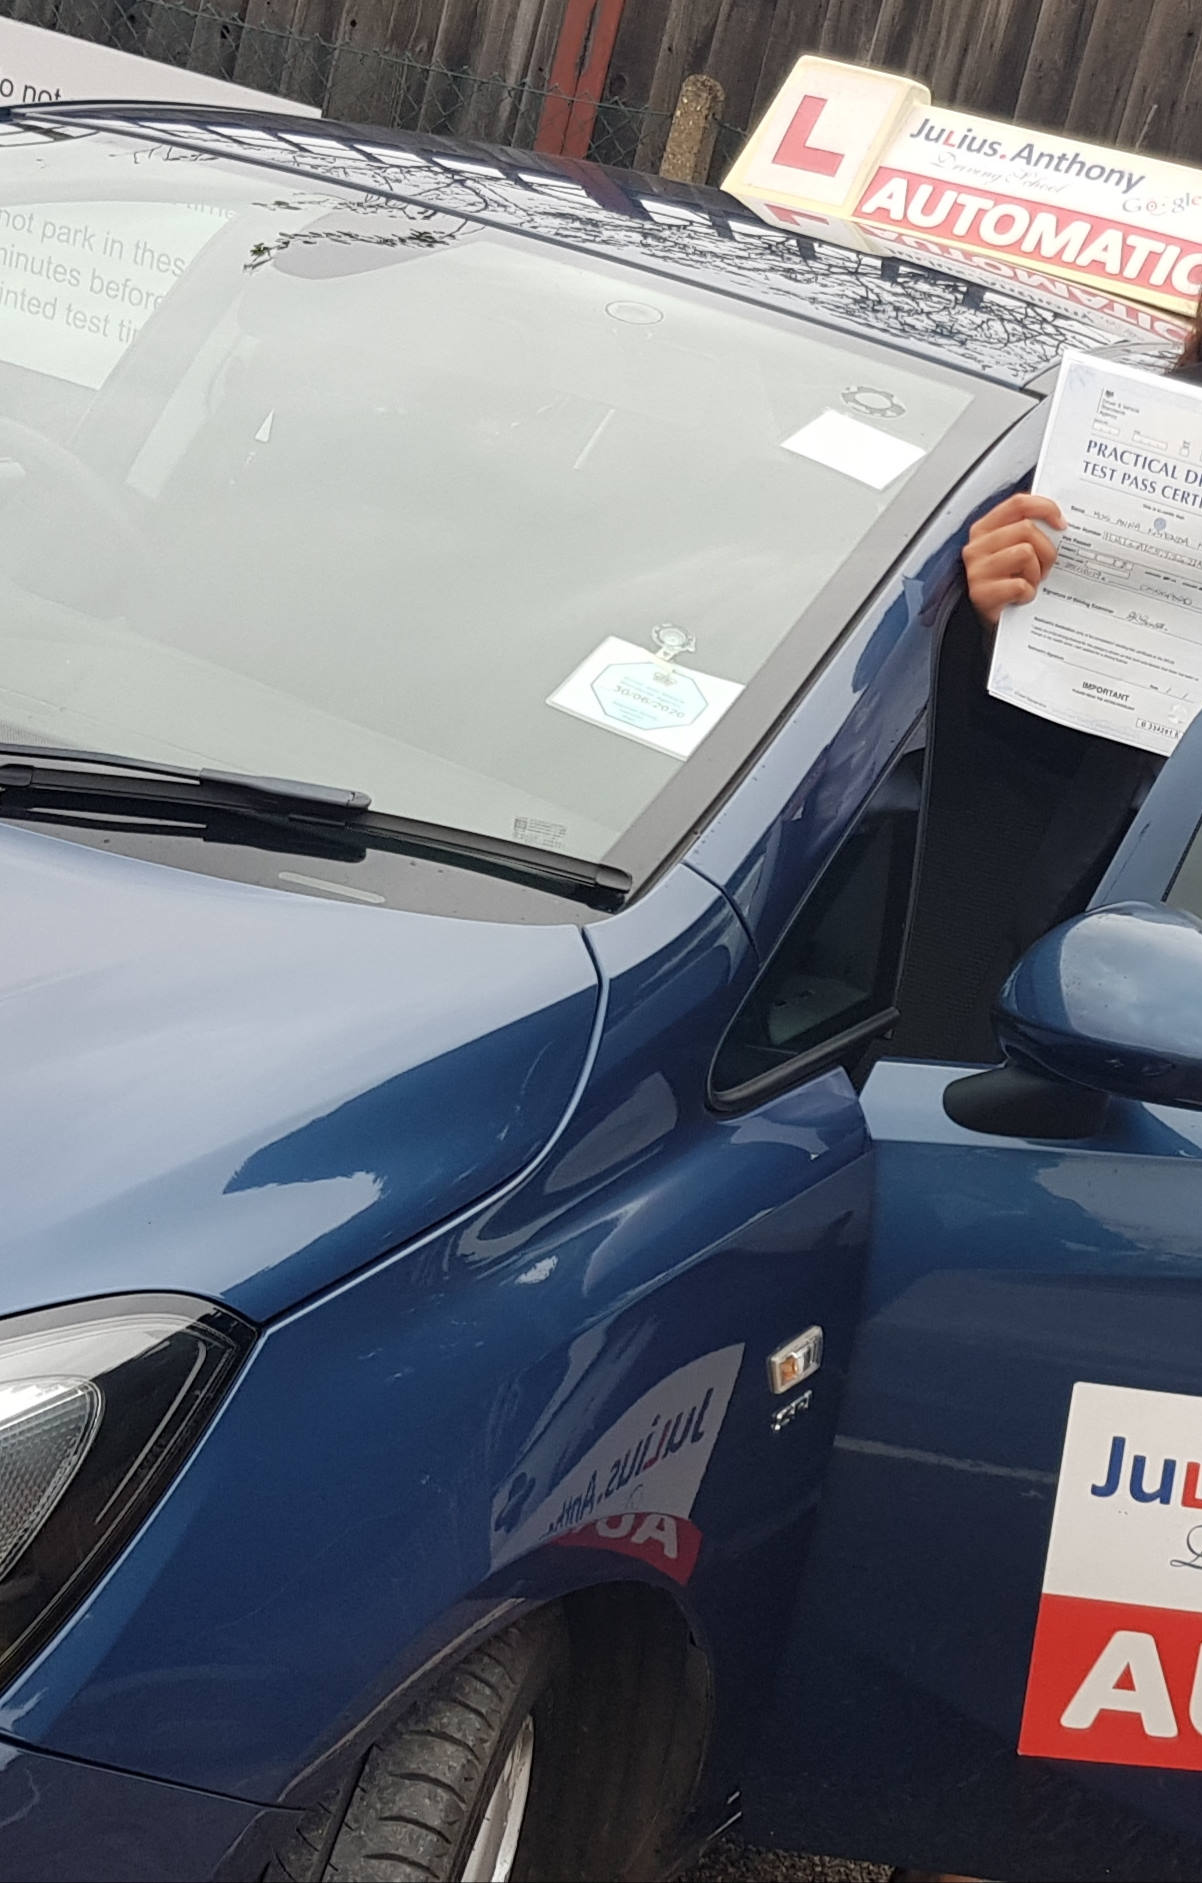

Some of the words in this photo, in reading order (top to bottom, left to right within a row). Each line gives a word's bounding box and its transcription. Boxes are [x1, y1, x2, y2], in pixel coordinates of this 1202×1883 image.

[772, 94, 845, 178] L
[41, 219, 96, 252] park
[103, 231, 124, 261] in
[65, 303, 110, 338] test
[1082, 461, 1117, 482] TEST
[1121, 472, 1157, 494] PASS
[1086, 439, 1178, 480] PRACTICAL
[1082, 680, 1130, 702] IMPORTANT
